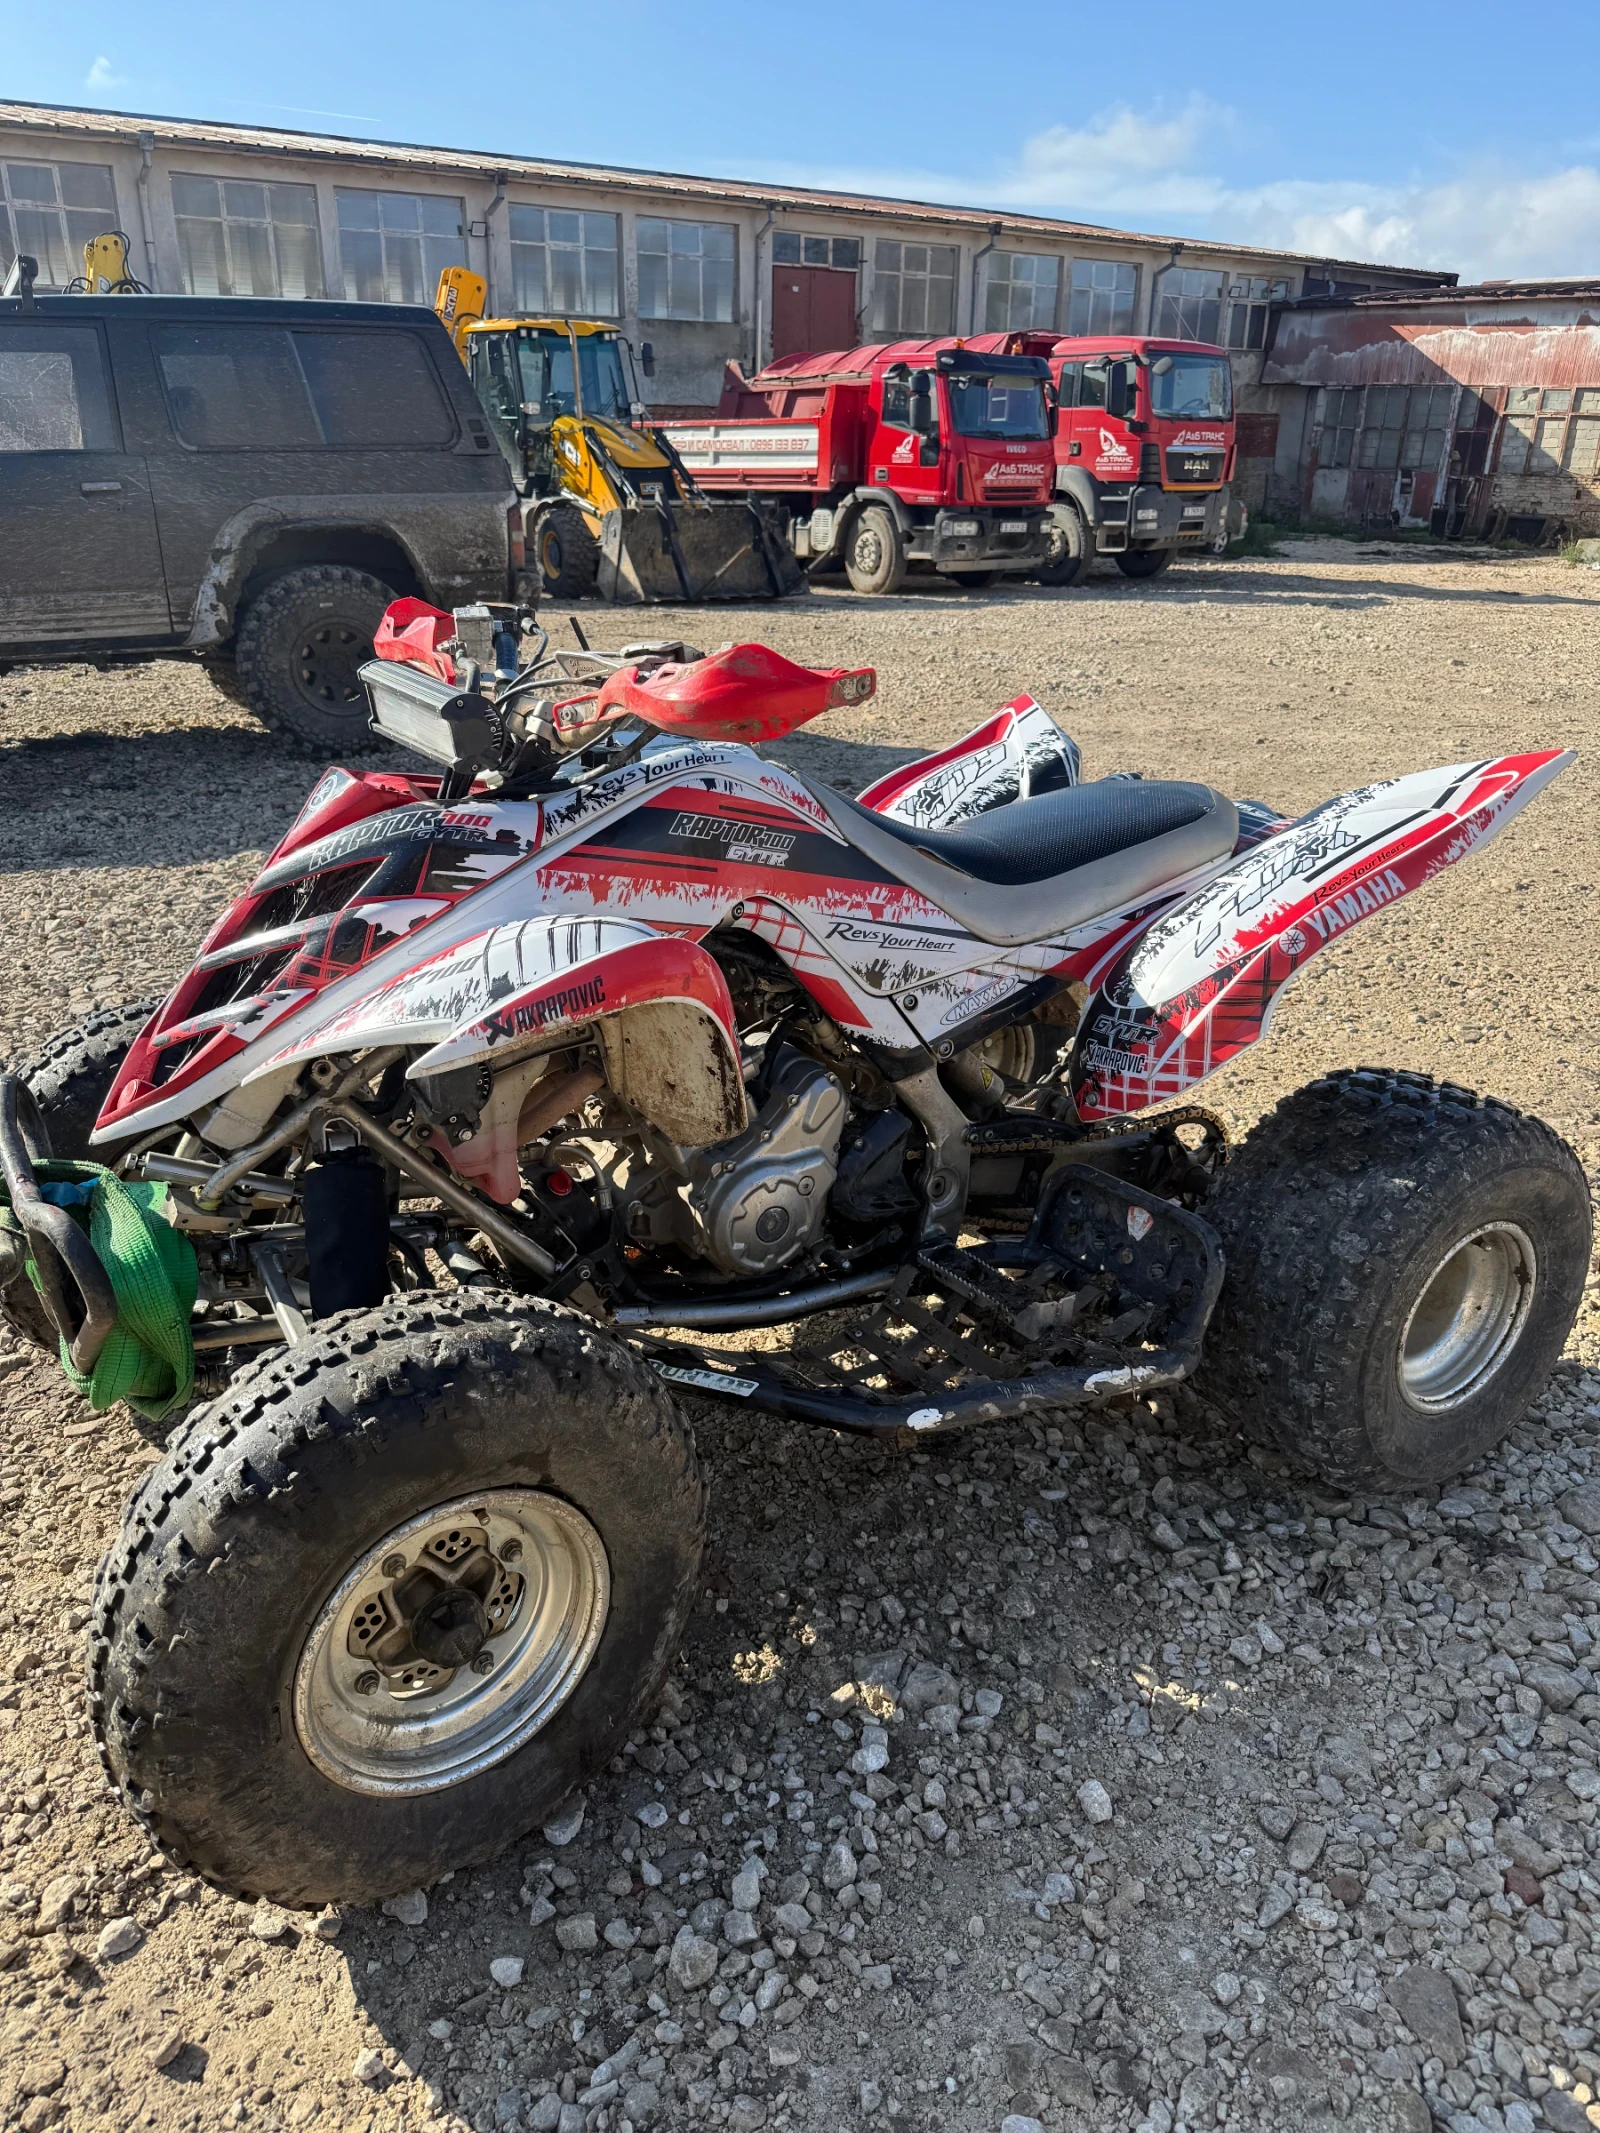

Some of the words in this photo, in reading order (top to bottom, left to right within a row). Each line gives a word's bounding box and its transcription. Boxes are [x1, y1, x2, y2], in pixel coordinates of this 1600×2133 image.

[750, 439, 773, 451] 0896
[775, 439, 789, 450] 133
[791, 439, 810, 450] 837
[1201, 432, 1225, 441] ТРАНС
[1006, 445, 1027, 453] IVECO
[1018, 464, 1044, 474] ТРАНС
[1184, 460, 1209, 469] MAN
[638, 759, 682, 784] Your
[725, 844, 789, 867] GYTR
[1308, 874, 1348, 906] Revs
[1349, 859, 1377, 880] Your
[1377, 842, 1406, 863] Heart
[1304, 868, 1407, 938] YAMAHA
[825, 921, 884, 940] Revs
[879, 931, 919, 949] Your
[919, 937, 956, 950] Heart
[954, 978, 1009, 1020] MAXXIS
[1091, 1014, 1162, 1046] GYTR
